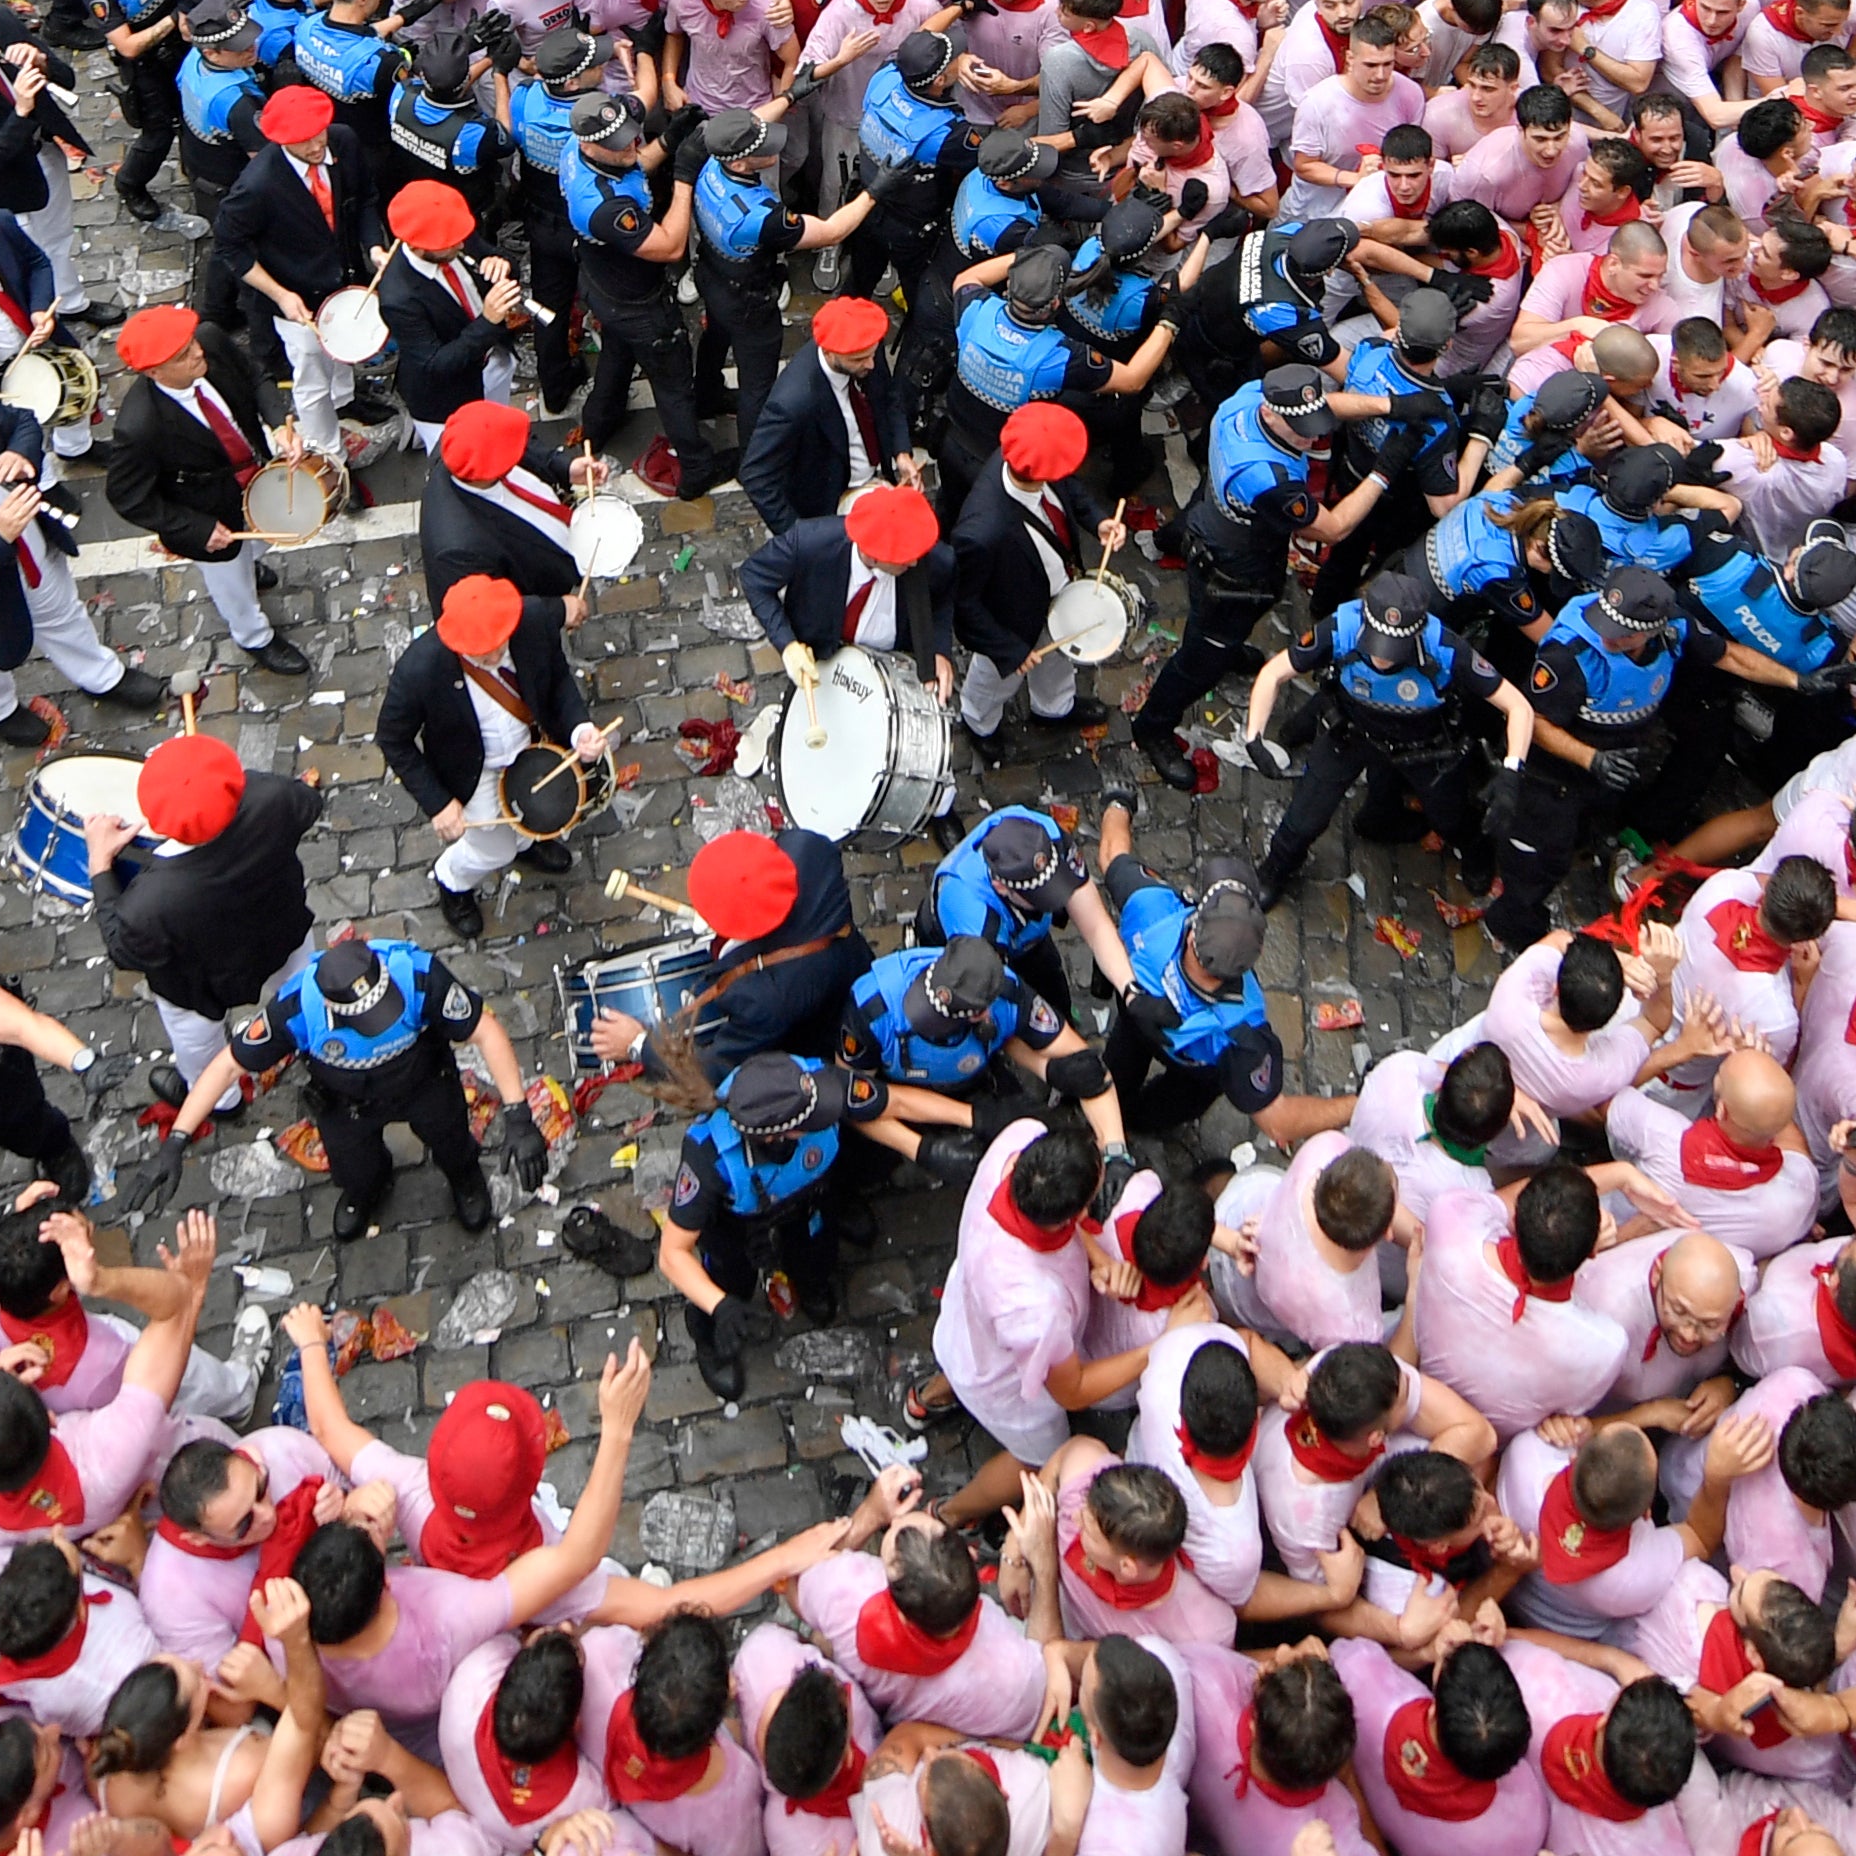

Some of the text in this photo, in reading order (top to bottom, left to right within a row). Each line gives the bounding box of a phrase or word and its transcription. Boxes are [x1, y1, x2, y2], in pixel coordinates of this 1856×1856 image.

[296, 45, 344, 83] POLICIA
[391, 122, 448, 159] POLICIA LOCAL
[526, 127, 568, 147] POLIC
[1250, 230, 1266, 300] POLICIA LOCAL
[965, 343, 1025, 386] POLICIA
[1733, 604, 1783, 656] POLICIA
